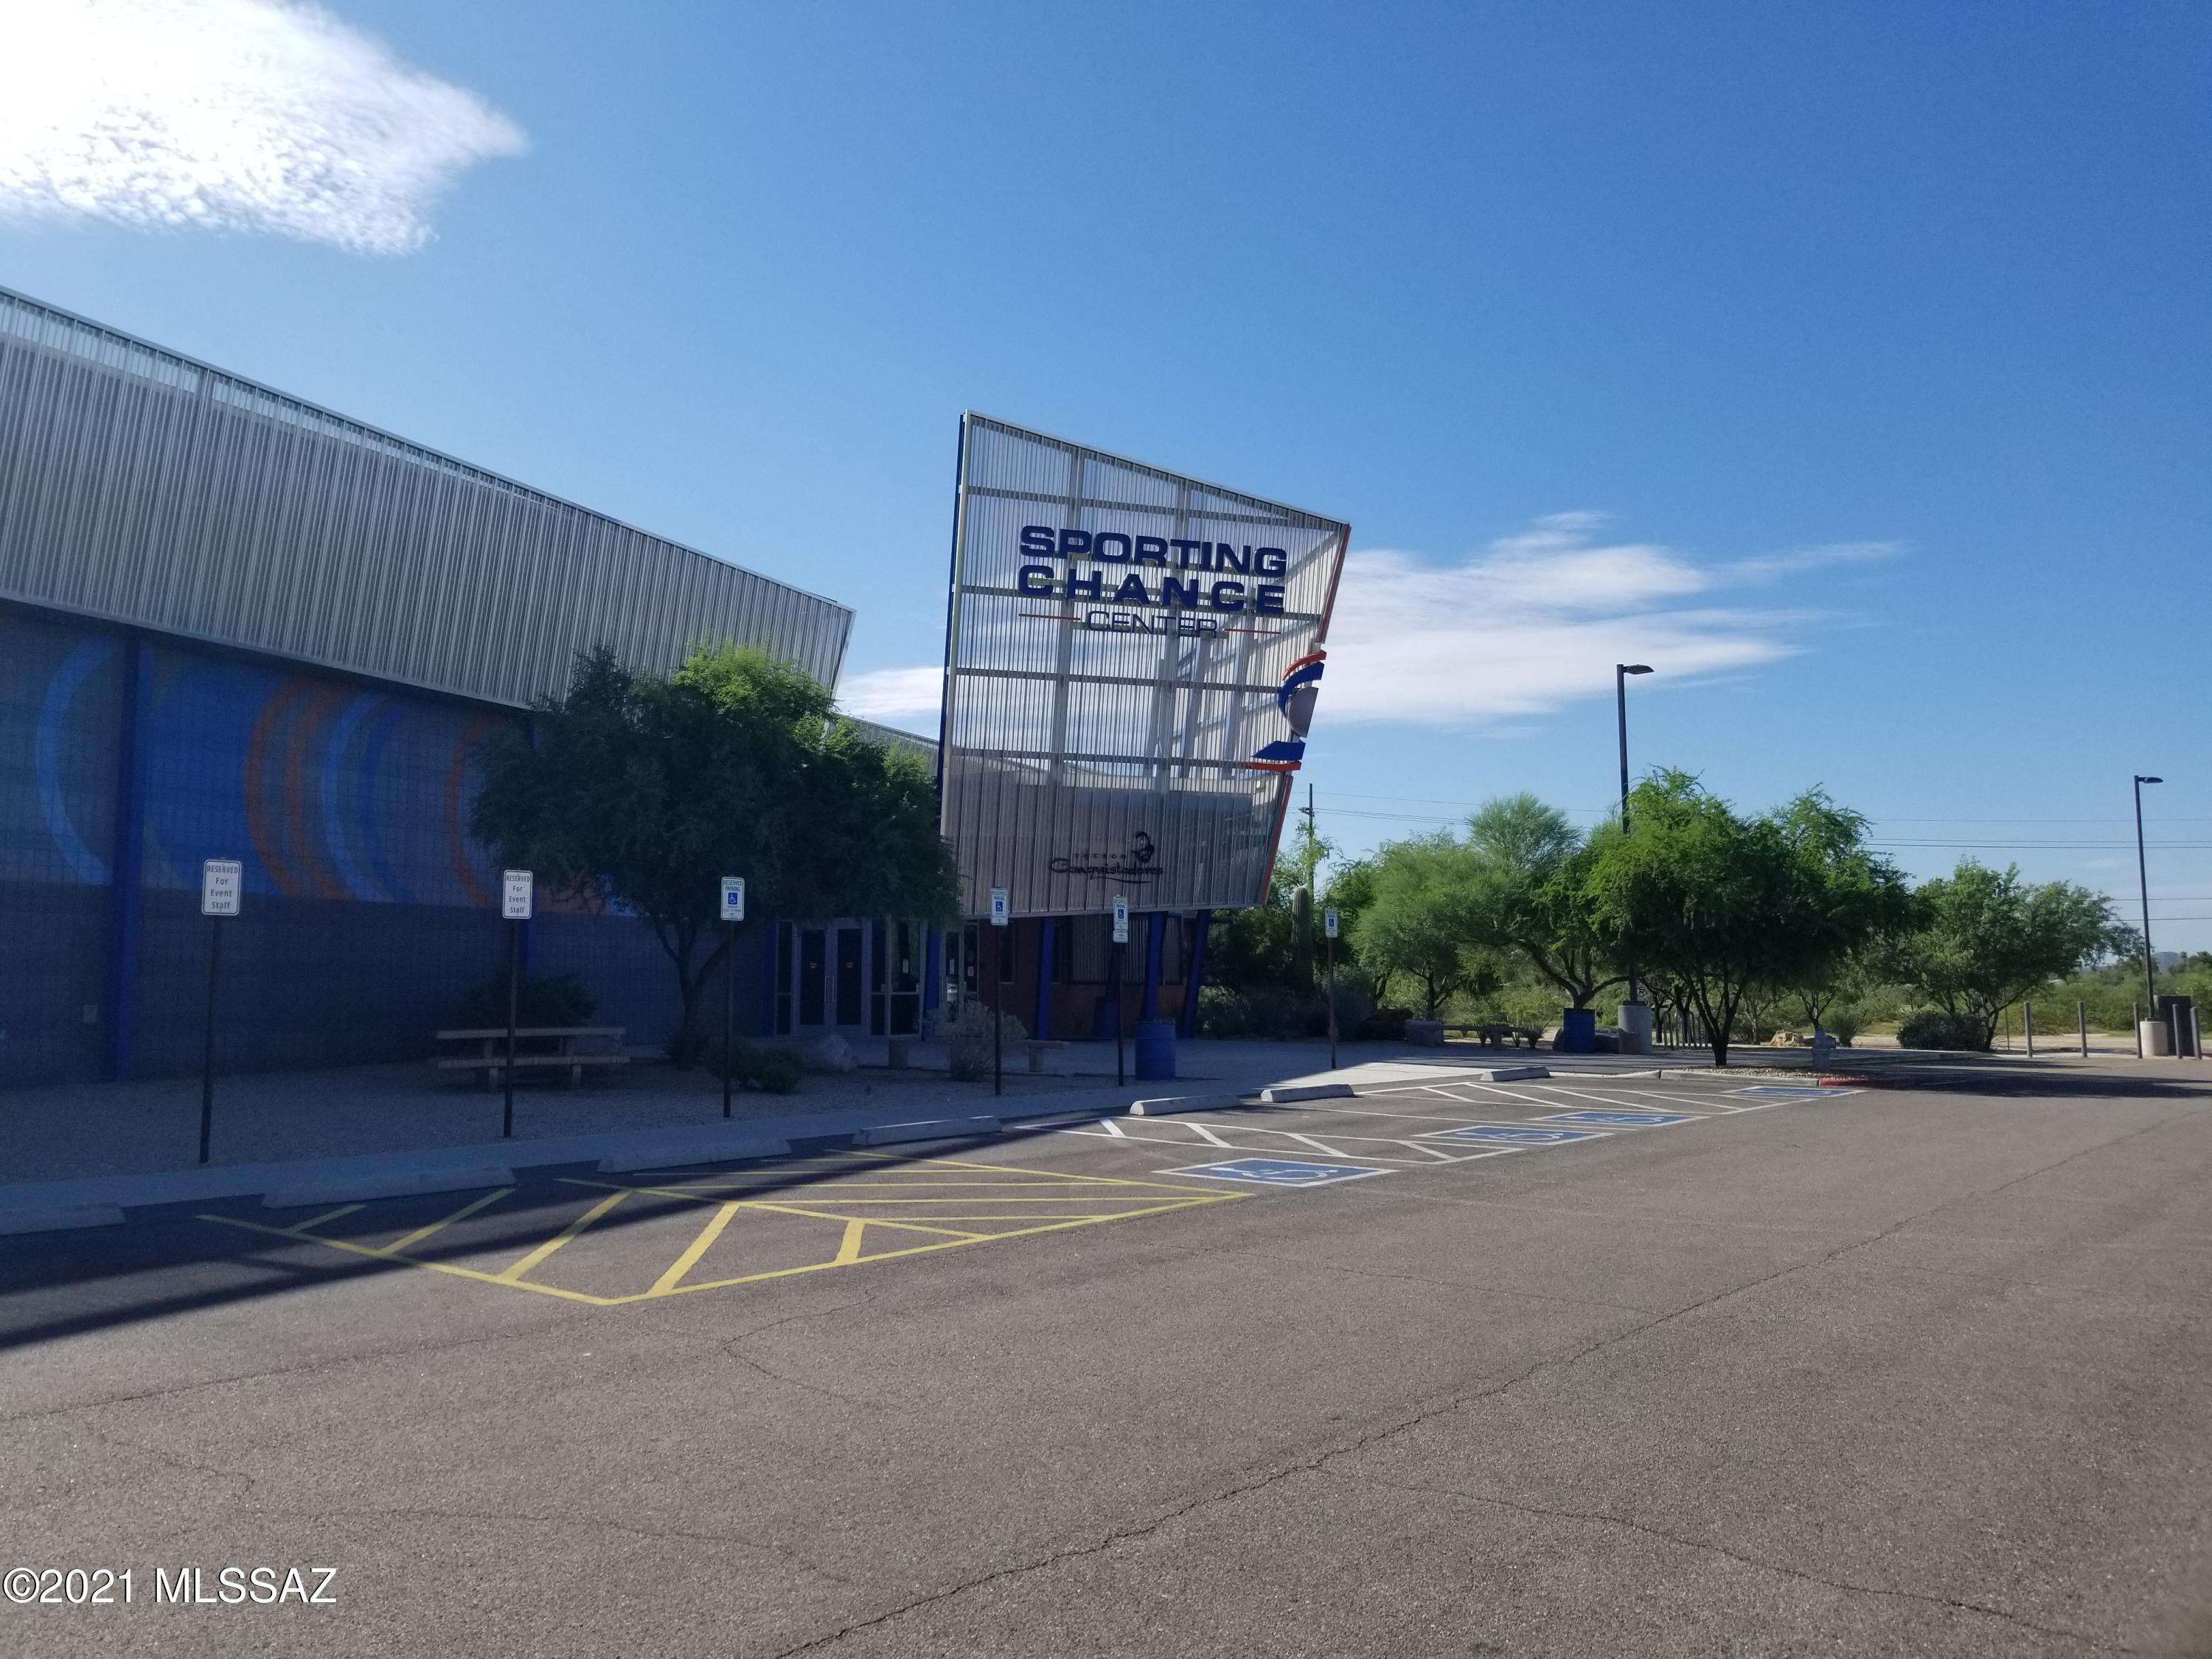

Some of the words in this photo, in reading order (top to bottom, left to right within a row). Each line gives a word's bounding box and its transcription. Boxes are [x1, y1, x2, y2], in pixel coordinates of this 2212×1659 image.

[1020, 525, 1287, 577] SPORTING
[1018, 565, 1285, 613] CHANCE
[1088, 611, 1218, 638] CENTER
[206, 866, 237, 874] RESERVED
[210, 889, 232, 897] Event
